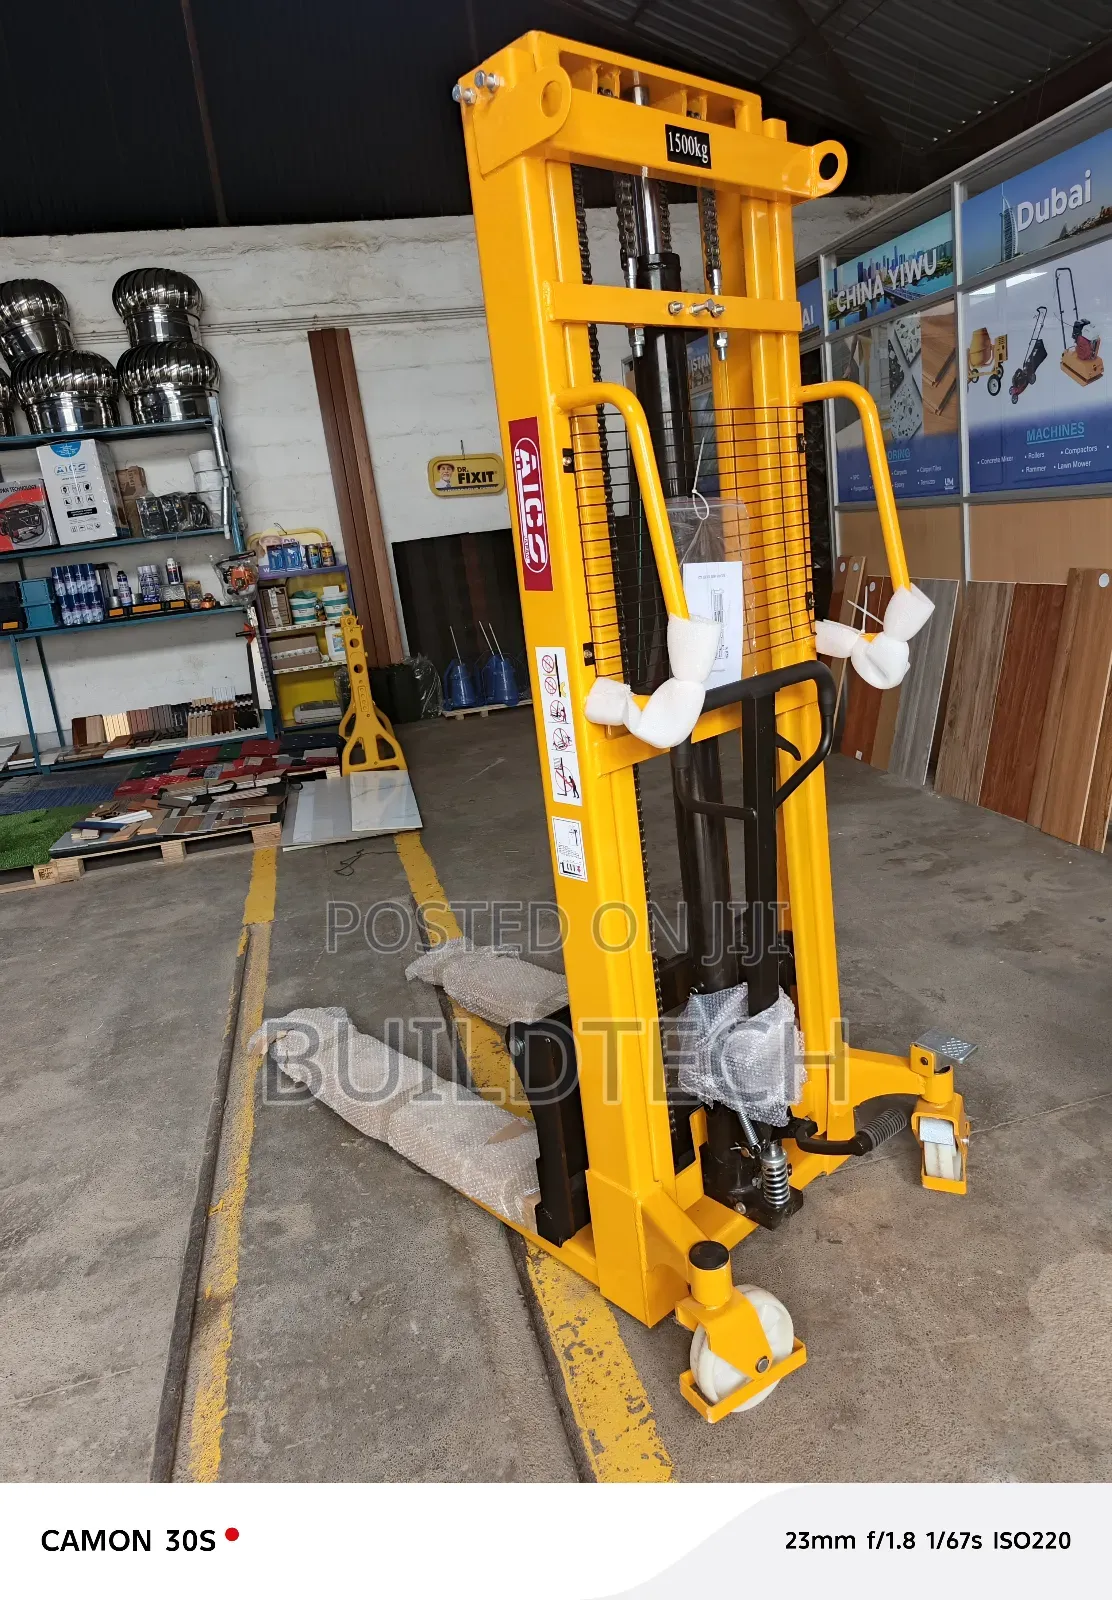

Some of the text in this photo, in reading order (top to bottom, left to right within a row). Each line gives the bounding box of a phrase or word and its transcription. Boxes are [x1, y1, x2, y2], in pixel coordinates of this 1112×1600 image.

[668, 131, 709, 163] 1500kg
[1017, 169, 1091, 232] Dubai
[837, 249, 936, 312] CHINA YIWU
[1026, 421, 1085, 442] MACHINES
[887, 447, 911, 460] ORING
[1028, 451, 1045, 459] Rollers
[1064, 445, 1098, 455] Compactors
[980, 457, 1000, 465] Concrete
[1057, 460, 1092, 470] Lawn Mower
[457, 471, 495, 485] FIXIT
[10, 484, 37, 492] TECHNOLOGY
